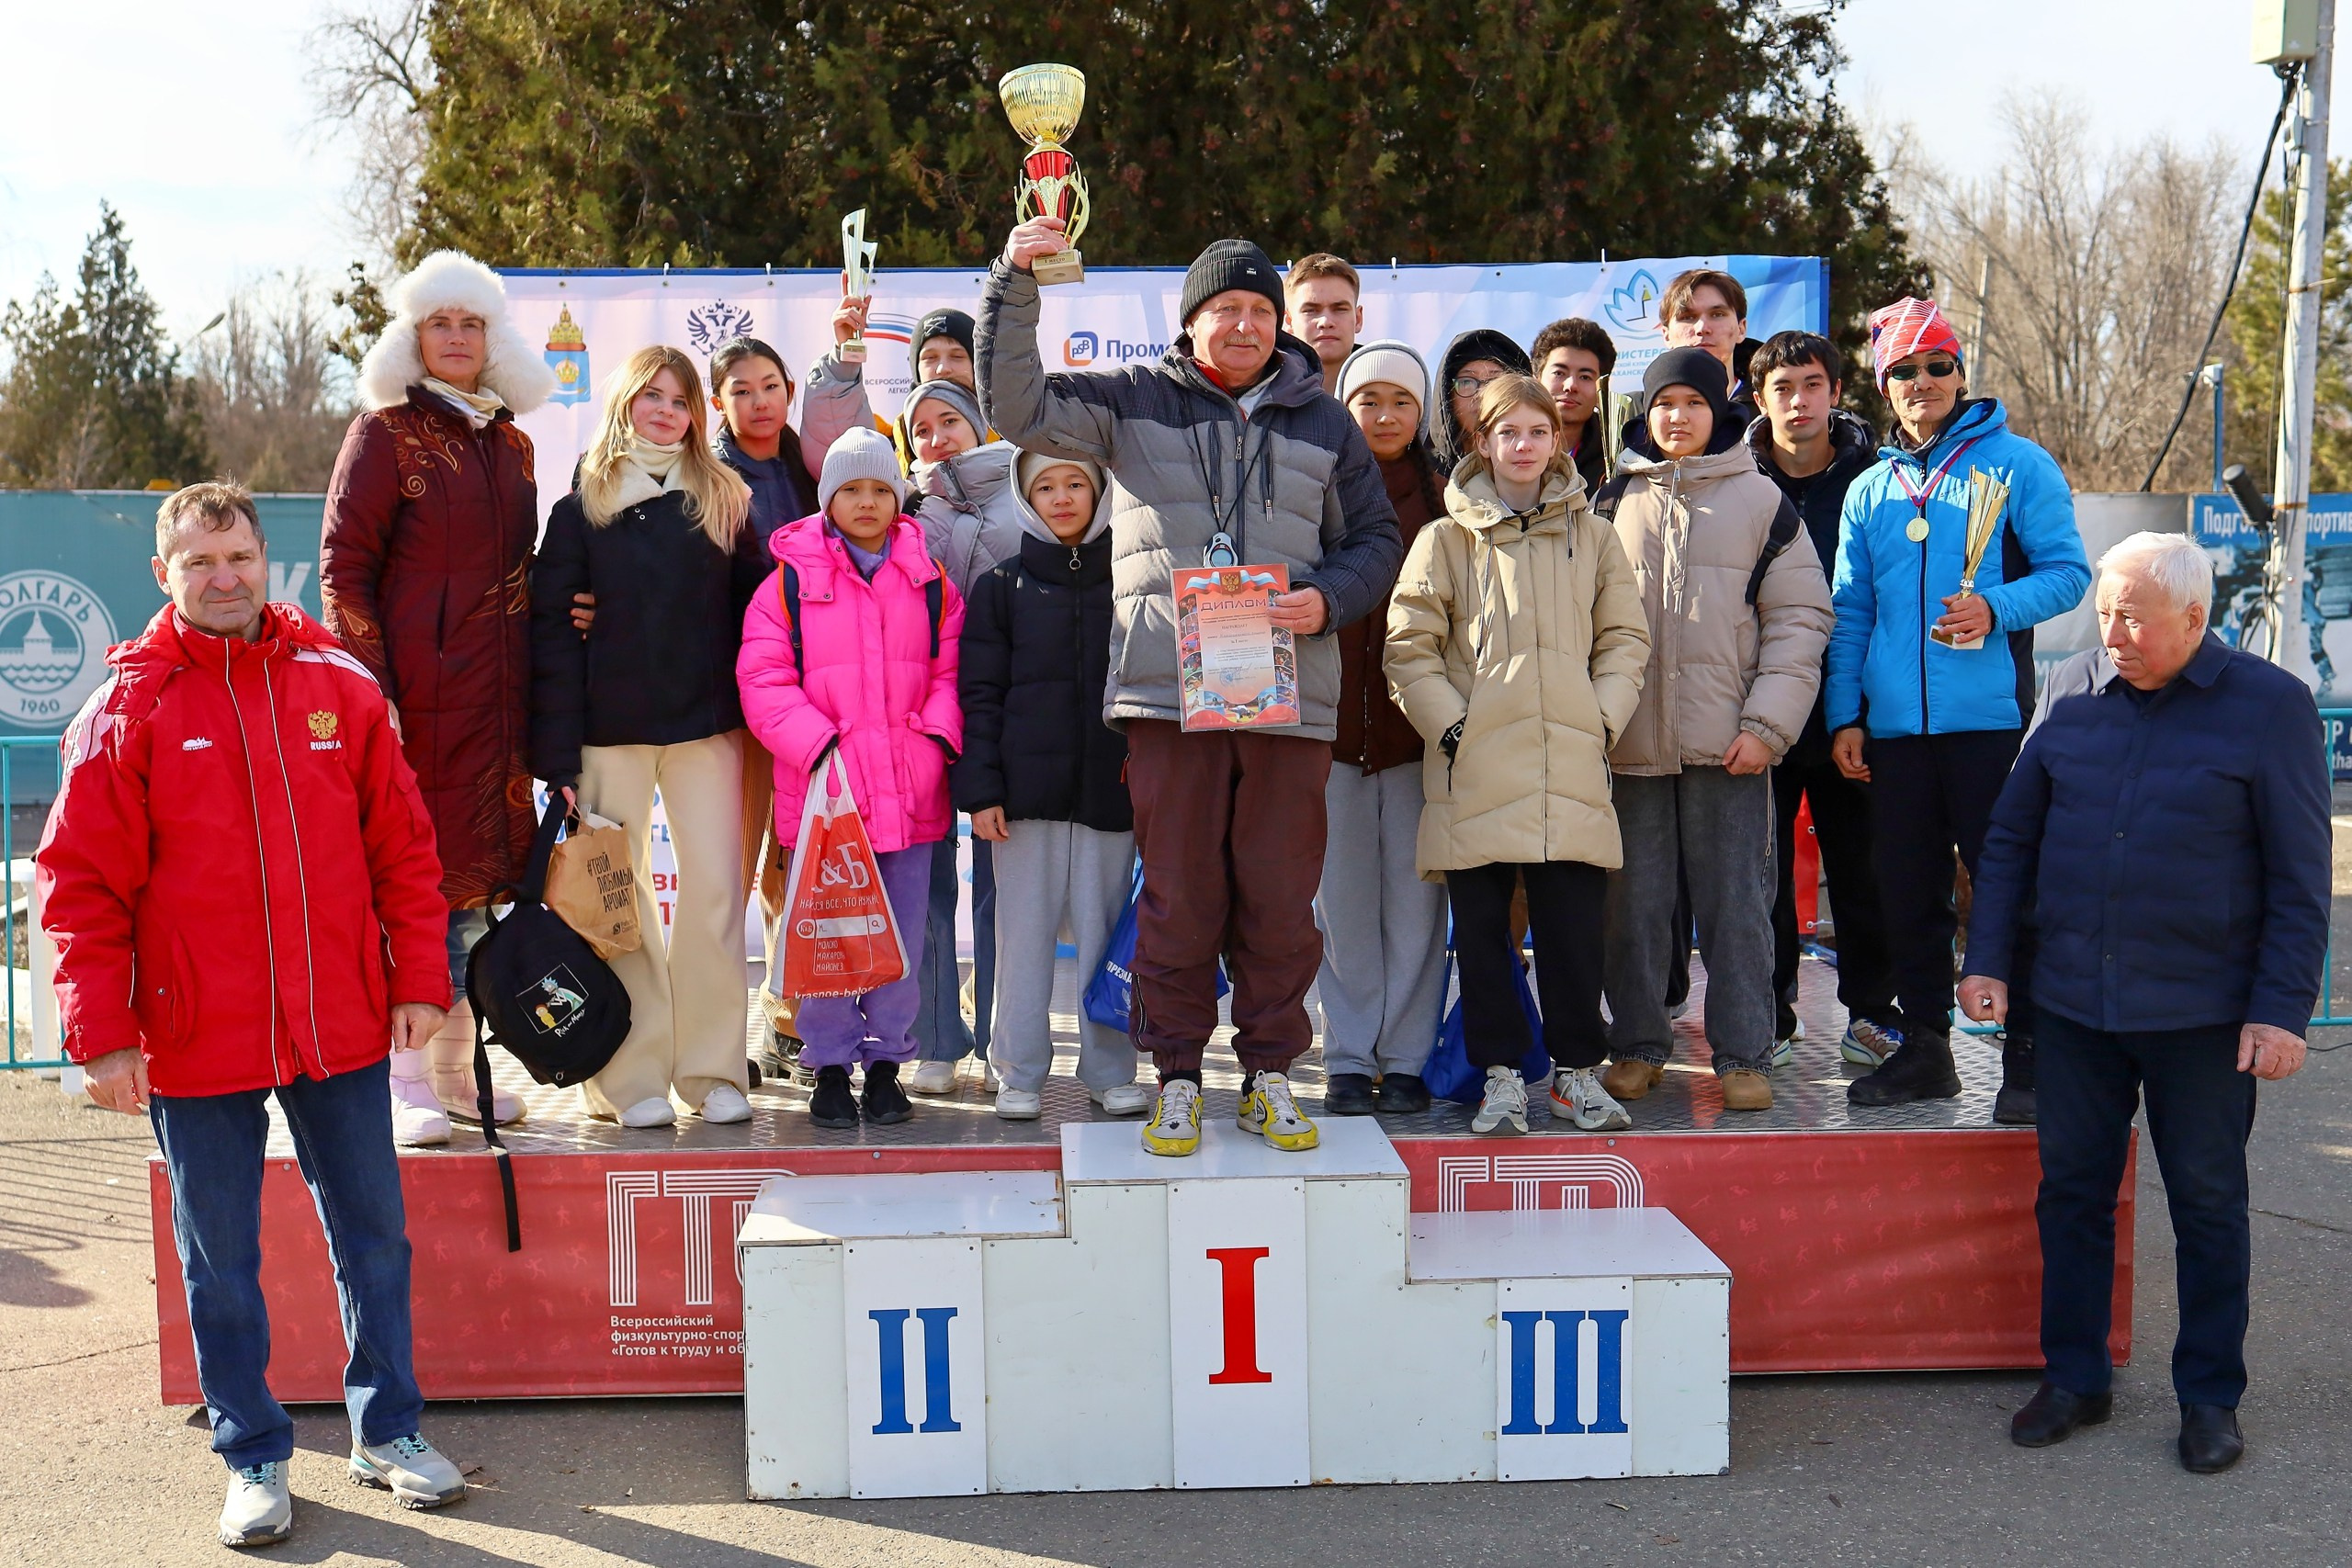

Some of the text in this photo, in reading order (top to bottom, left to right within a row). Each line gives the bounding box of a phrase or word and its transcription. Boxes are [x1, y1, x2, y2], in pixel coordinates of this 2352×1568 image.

[1200, 598, 1266, 612] ДИПЛОМ
[20, 699, 61, 715] 1960
[310, 739, 342, 750] RUSSIA
[587, 852, 611, 876] #ТВОЙ
[597, 864, 634, 895] ЛЮБИМЫЙ
[603, 887, 632, 913] АРОМАТ
[842, 897, 857, 908] ЧТО
[818, 940, 838, 950] МОЛОКО
[816, 962, 843, 972] МАЙОНЕЗ
[610, 1314, 714, 1329] Всероссийский
[1206, 1247, 1272, 1385] I
[611, 1344, 657, 1356] «Готов
[661, 1347, 668, 1355] к
[672, 1346, 711, 1358] труду
[716, 1346, 724, 1354] и
[869, 1307, 961, 1435] II
[1502, 1310, 1629, 1435] III
